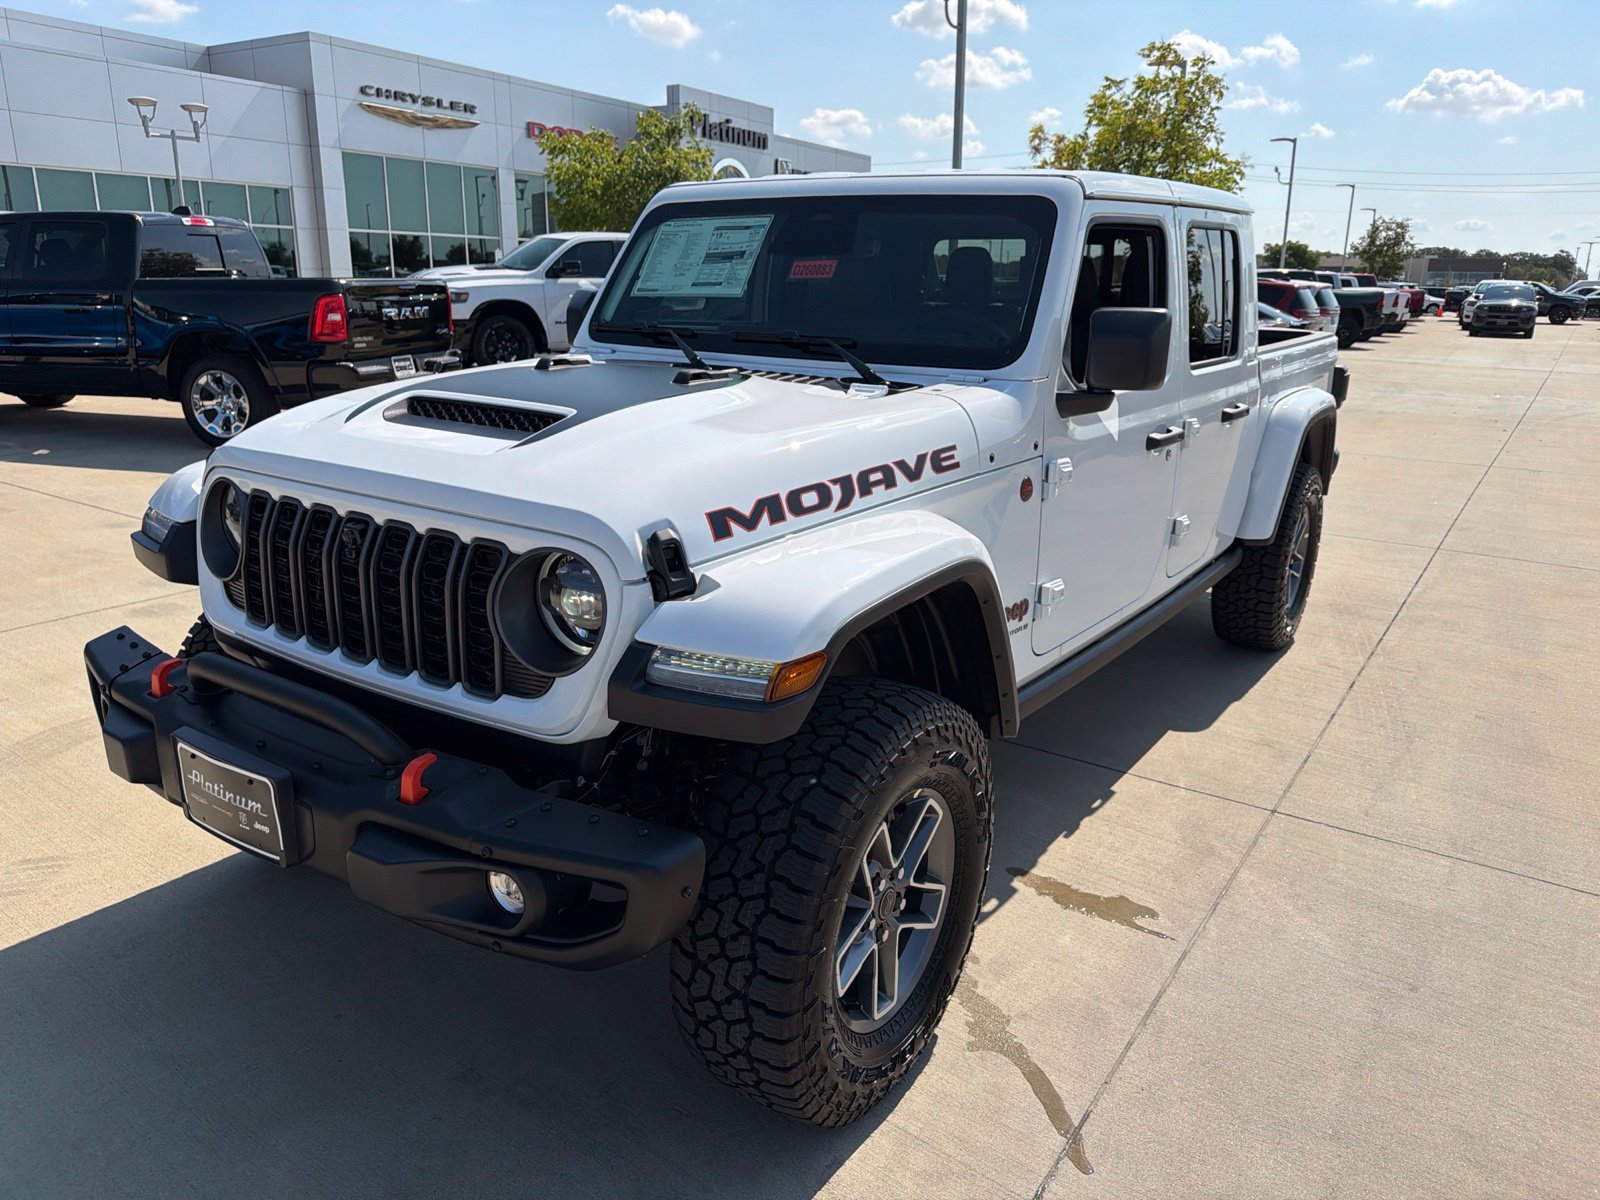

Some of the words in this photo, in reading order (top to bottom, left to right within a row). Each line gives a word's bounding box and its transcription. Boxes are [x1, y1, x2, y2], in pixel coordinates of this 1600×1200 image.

[359, 84, 477, 115] CHRYSLER
[381, 306, 429, 321] RAM
[704, 444, 961, 543] MOJAVE
[187, 769, 268, 818] Platinum
[253, 820, 270, 835] Jeep
